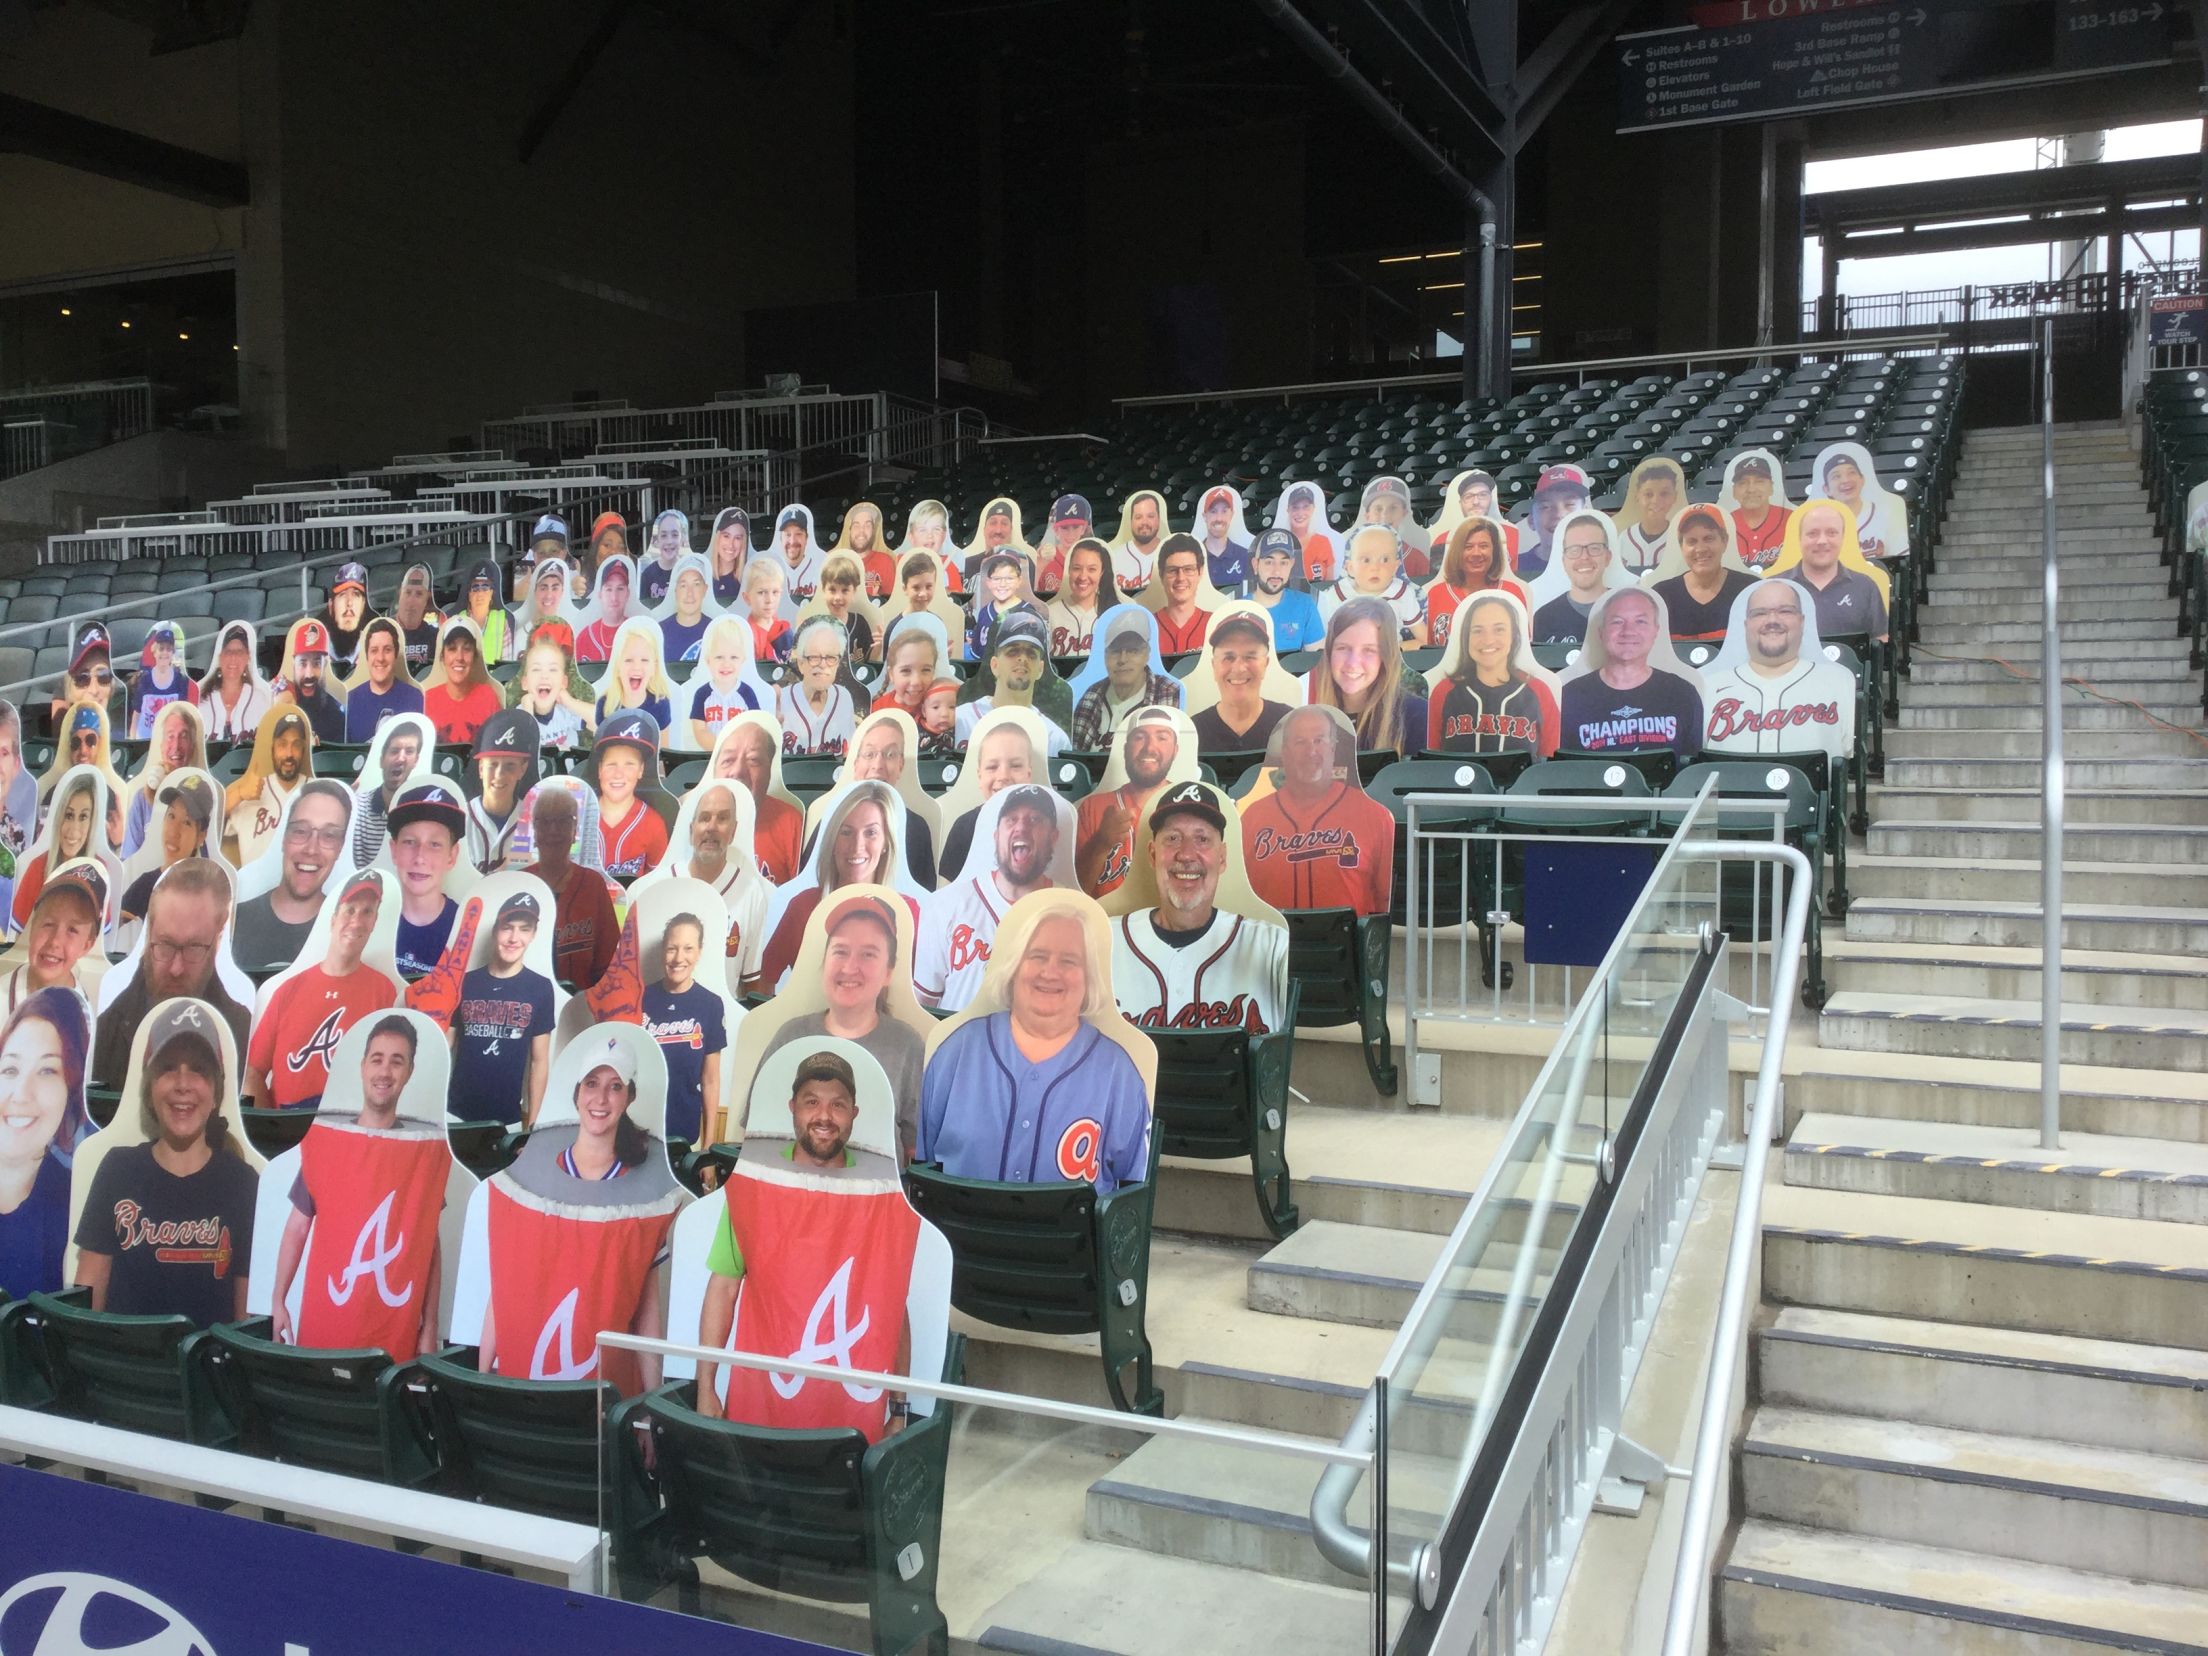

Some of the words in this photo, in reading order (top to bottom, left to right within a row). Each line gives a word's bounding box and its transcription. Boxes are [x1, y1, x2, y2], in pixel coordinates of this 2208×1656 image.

[1821, 17, 1886, 32] Restrooms
[2069, 8, 2138, 31] 133-163
[1645, 46, 1681, 57] Suites
[1709, 37, 1720, 49] &
[1794, 41, 1814, 51] 3rd
[1817, 37, 1847, 49] Base
[1850, 32, 1885, 45] Ramp
[1659, 54, 1719, 71] Restrooms
[1772, 59, 1800, 72] Hope
[1801, 56, 1812, 67] &
[1828, 66, 1859, 80] Chop
[1862, 61, 1899, 74] House
[1659, 71, 1710, 86] Elevators
[1659, 85, 1718, 101] Monument
[1721, 79, 1761, 93] Garden
[1797, 86, 1820, 98] Left
[1823, 83, 1852, 95] Field
[1854, 80, 1883, 91] Gate
[1659, 105, 1677, 117] 1st
[1680, 101, 1709, 113] Base
[1711, 98, 1739, 110] Gate
[2153, 298, 2204, 310] CAUTION
[2164, 330, 2192, 338] WATCH
[790, 507, 798, 519] T
[1065, 503, 1079, 516] A
[1226, 559, 1242, 575] A
[1837, 593, 1852, 607] A
[81, 628, 102, 645] A
[1050, 626, 1094, 657] Bra
[1445, 713, 1537, 744] BRAVES
[1707, 697, 1840, 742] Braves
[494, 726, 515, 745] A
[620, 721, 641, 739] A
[1579, 715, 1677, 747] CHAMPIONS
[1620, 735, 1638, 745] EAST
[1639, 733, 1667, 744] DIVISION
[1172, 783, 1201, 803] A
[1255, 826, 1342, 861] Braves
[514, 894, 532, 907] A
[171, 1004, 201, 1028] A
[461, 999, 534, 1028] BRAVES
[287, 1006, 346, 1074] A
[464, 1023, 504, 1040] BASEBALL
[482, 1039, 500, 1056] A
[114, 1198, 220, 1251] Braves
[327, 1190, 413, 1308] A
[768, 1256, 888, 1404] A
